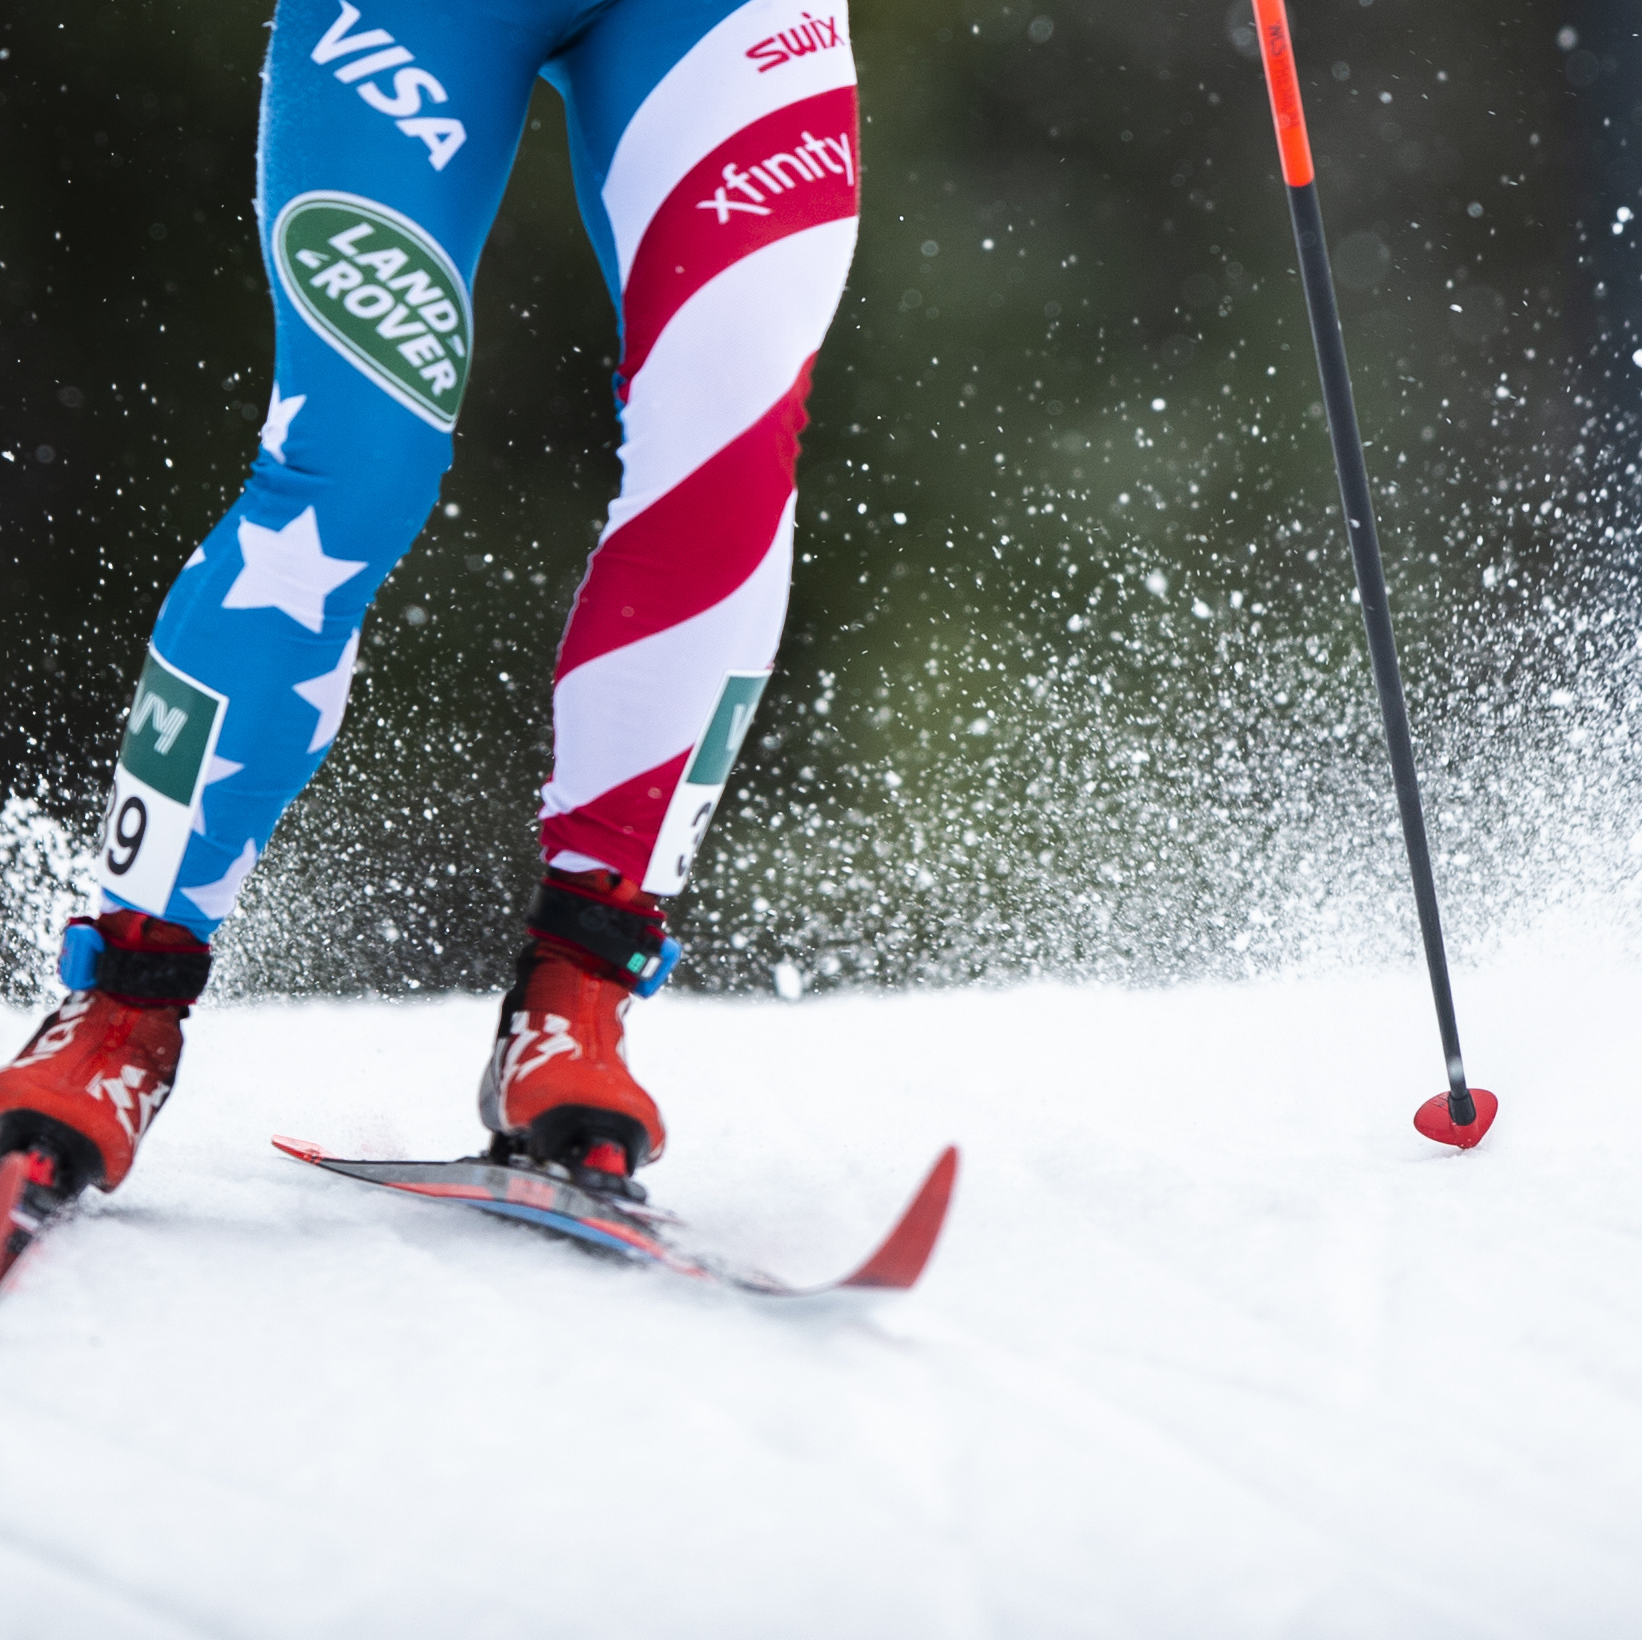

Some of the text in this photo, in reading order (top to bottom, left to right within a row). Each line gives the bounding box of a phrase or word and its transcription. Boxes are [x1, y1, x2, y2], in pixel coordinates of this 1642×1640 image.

[695, 130, 855, 225] xfinity
[310, 259, 458, 398] ROVER
[328, 222, 460, 334] LAND
